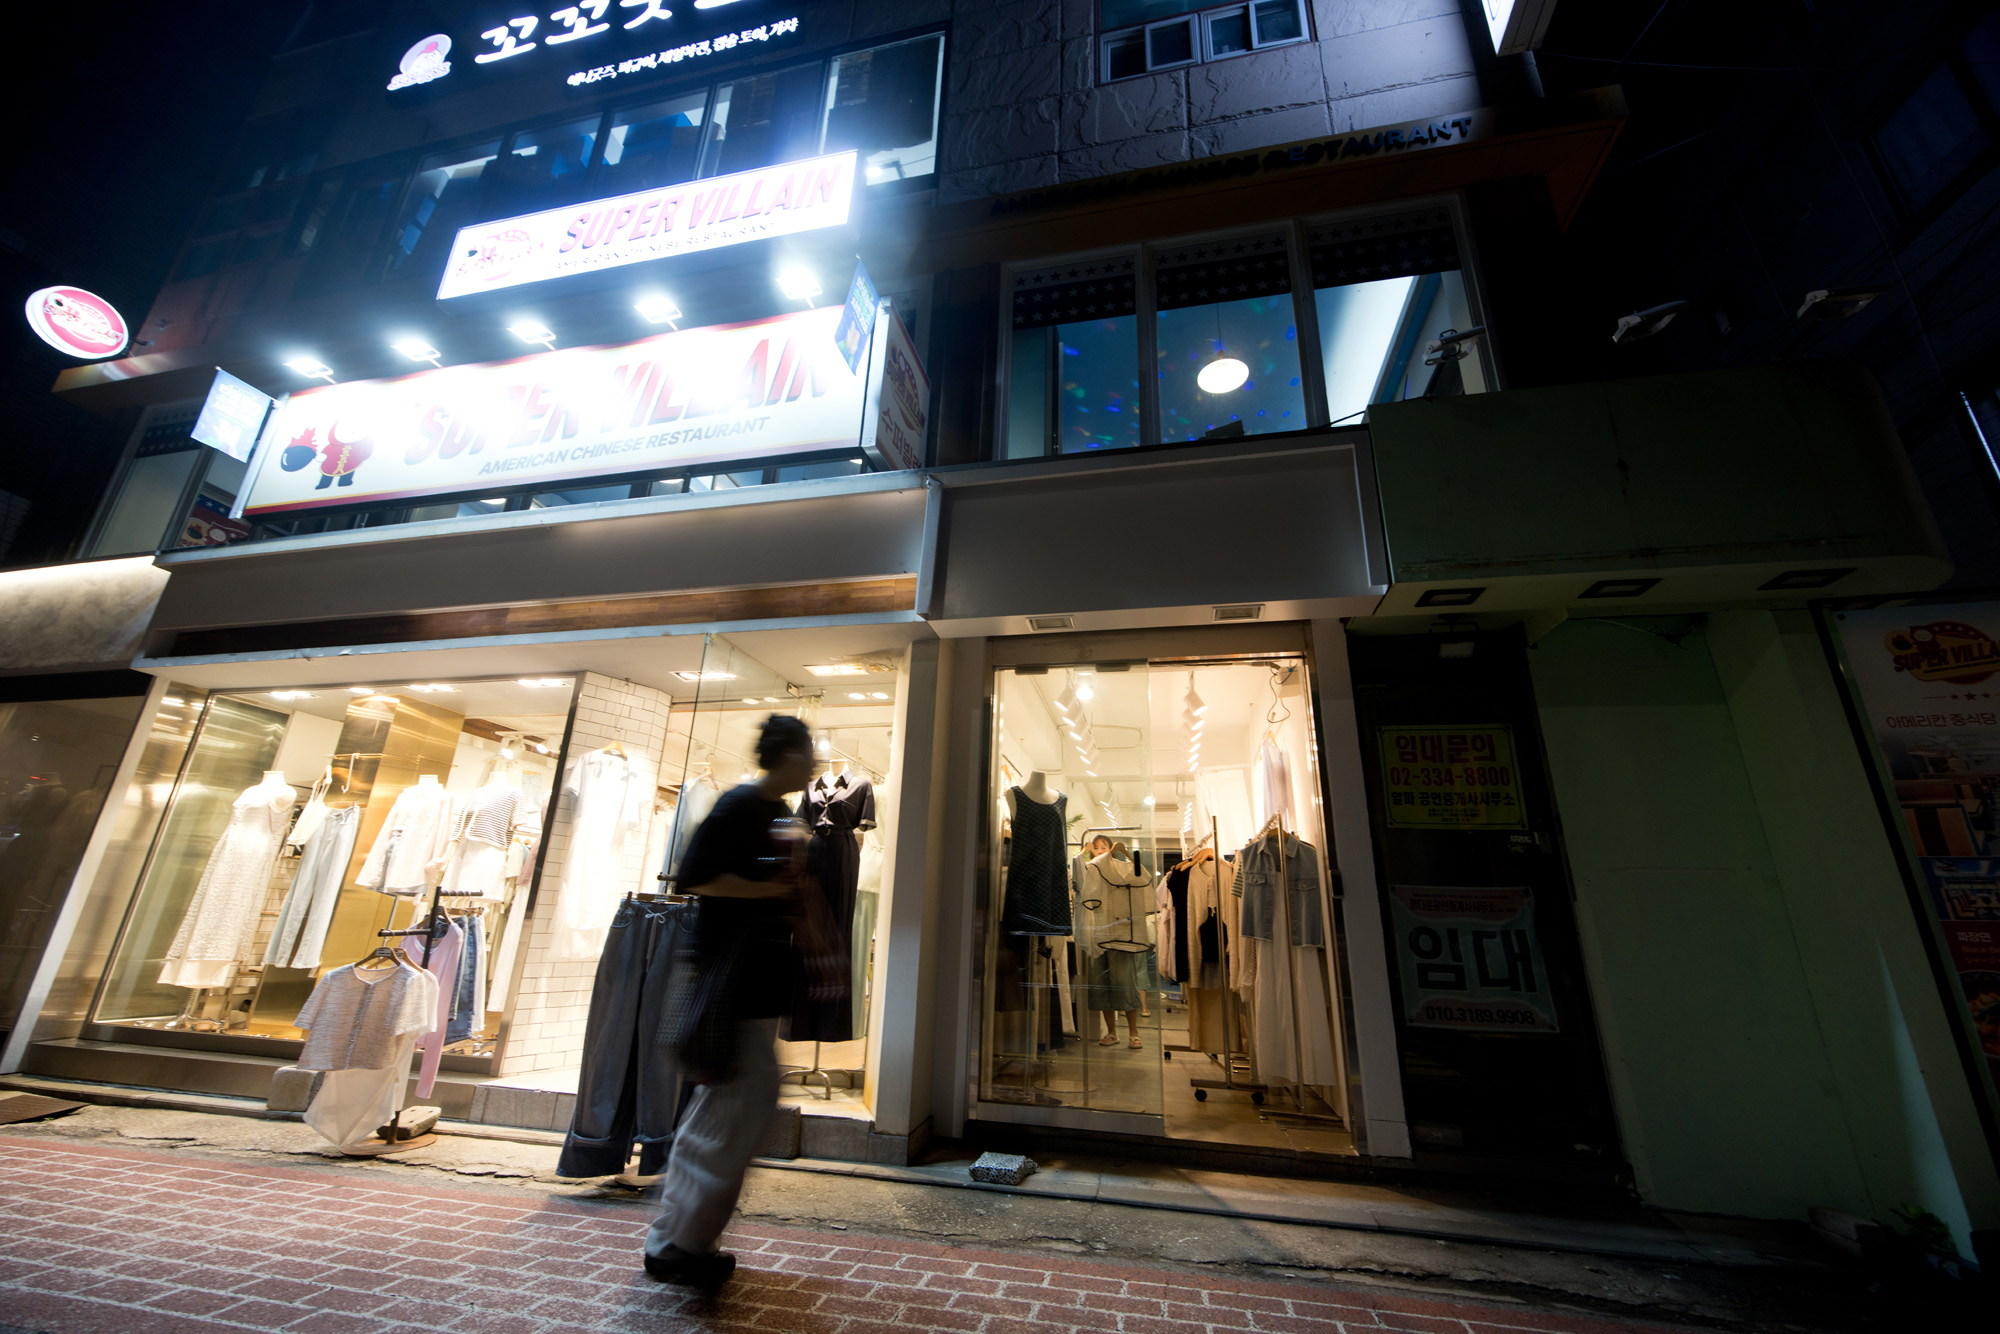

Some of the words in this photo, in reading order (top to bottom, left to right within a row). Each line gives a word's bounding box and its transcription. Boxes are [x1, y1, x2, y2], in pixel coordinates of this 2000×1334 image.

[1263, 116, 1473, 169] RESTAURANT
[559, 193, 686, 255] SUPER
[688, 163, 844, 230] VILLAIN
[478, 447, 571, 477] AMERICAN
[571, 436, 648, 464] CHINESE
[646, 416, 771, 450] RESTAURANT
[1893, 648, 1950, 673] SUPER
[1886, 713, 1947, 729] 아메리칸
[1949, 712, 1998, 727] 중식당
[1394, 733, 1497, 764] 임대문의
[1389, 766, 1511, 787] 02-334-8800
[1391, 791, 1415, 806] 알파
[1418, 791, 1515, 807] 공인중개사사무소
[1407, 926, 1538, 993] 임대
[1425, 1005, 1536, 1025] 010.3189.9908
